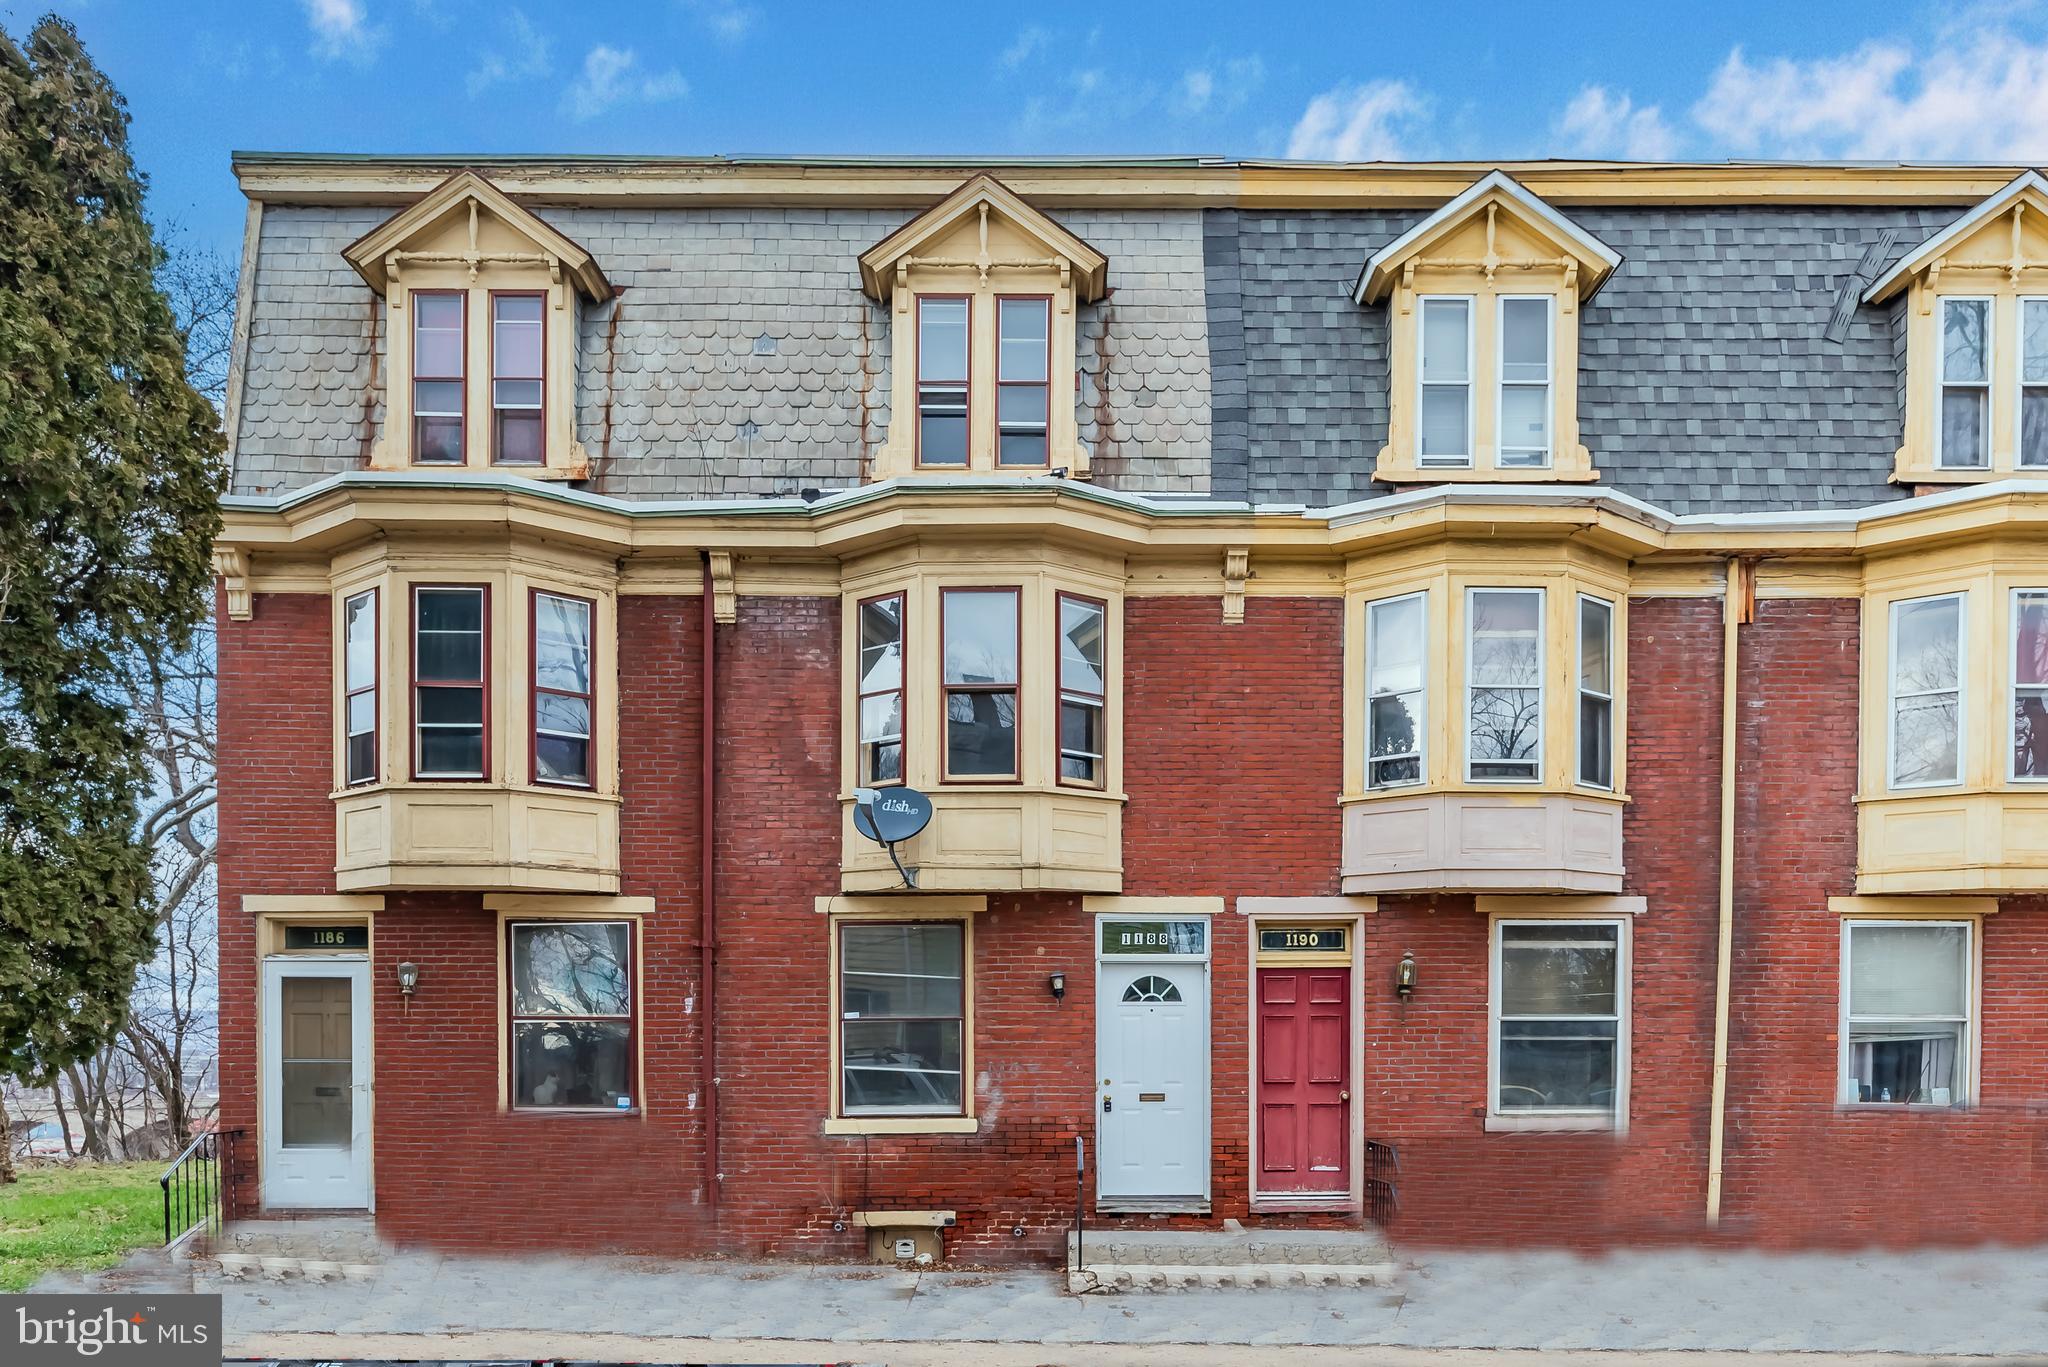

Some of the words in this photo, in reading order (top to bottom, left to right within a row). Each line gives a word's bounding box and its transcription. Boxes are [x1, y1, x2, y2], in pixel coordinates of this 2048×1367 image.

[882, 799, 909, 812] dish
[314, 931, 345, 944] 1186
[1122, 933, 1167, 944] 1188
[1286, 933, 1319, 946] 1190
